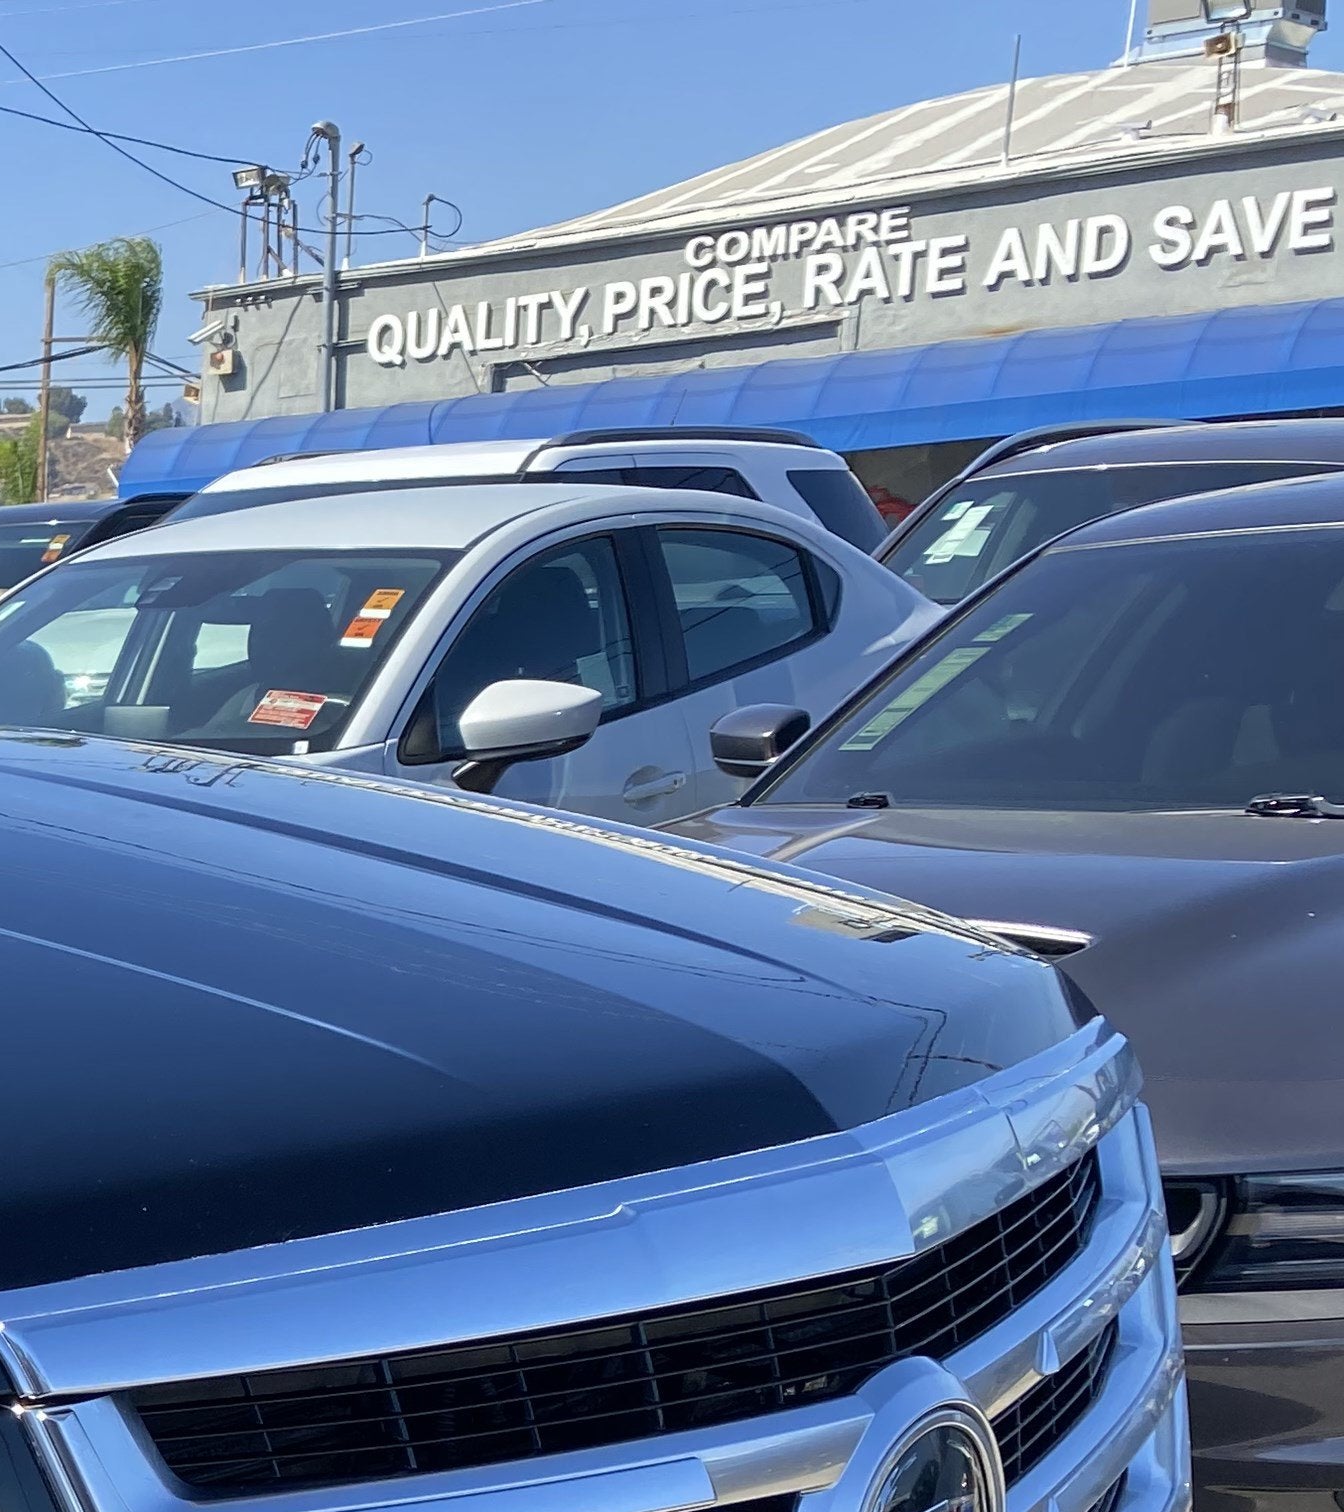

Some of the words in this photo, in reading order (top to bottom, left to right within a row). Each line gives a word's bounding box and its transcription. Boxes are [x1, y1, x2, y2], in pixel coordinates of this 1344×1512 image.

[367, 287, 591, 366] QUALITY,
[603, 262, 783, 333] PRICE,
[804, 234, 967, 308] RATE
[983, 213, 1129, 286] AND
[1148, 187, 1335, 265] SAVE
[685, 206, 911, 268] COMPARE
